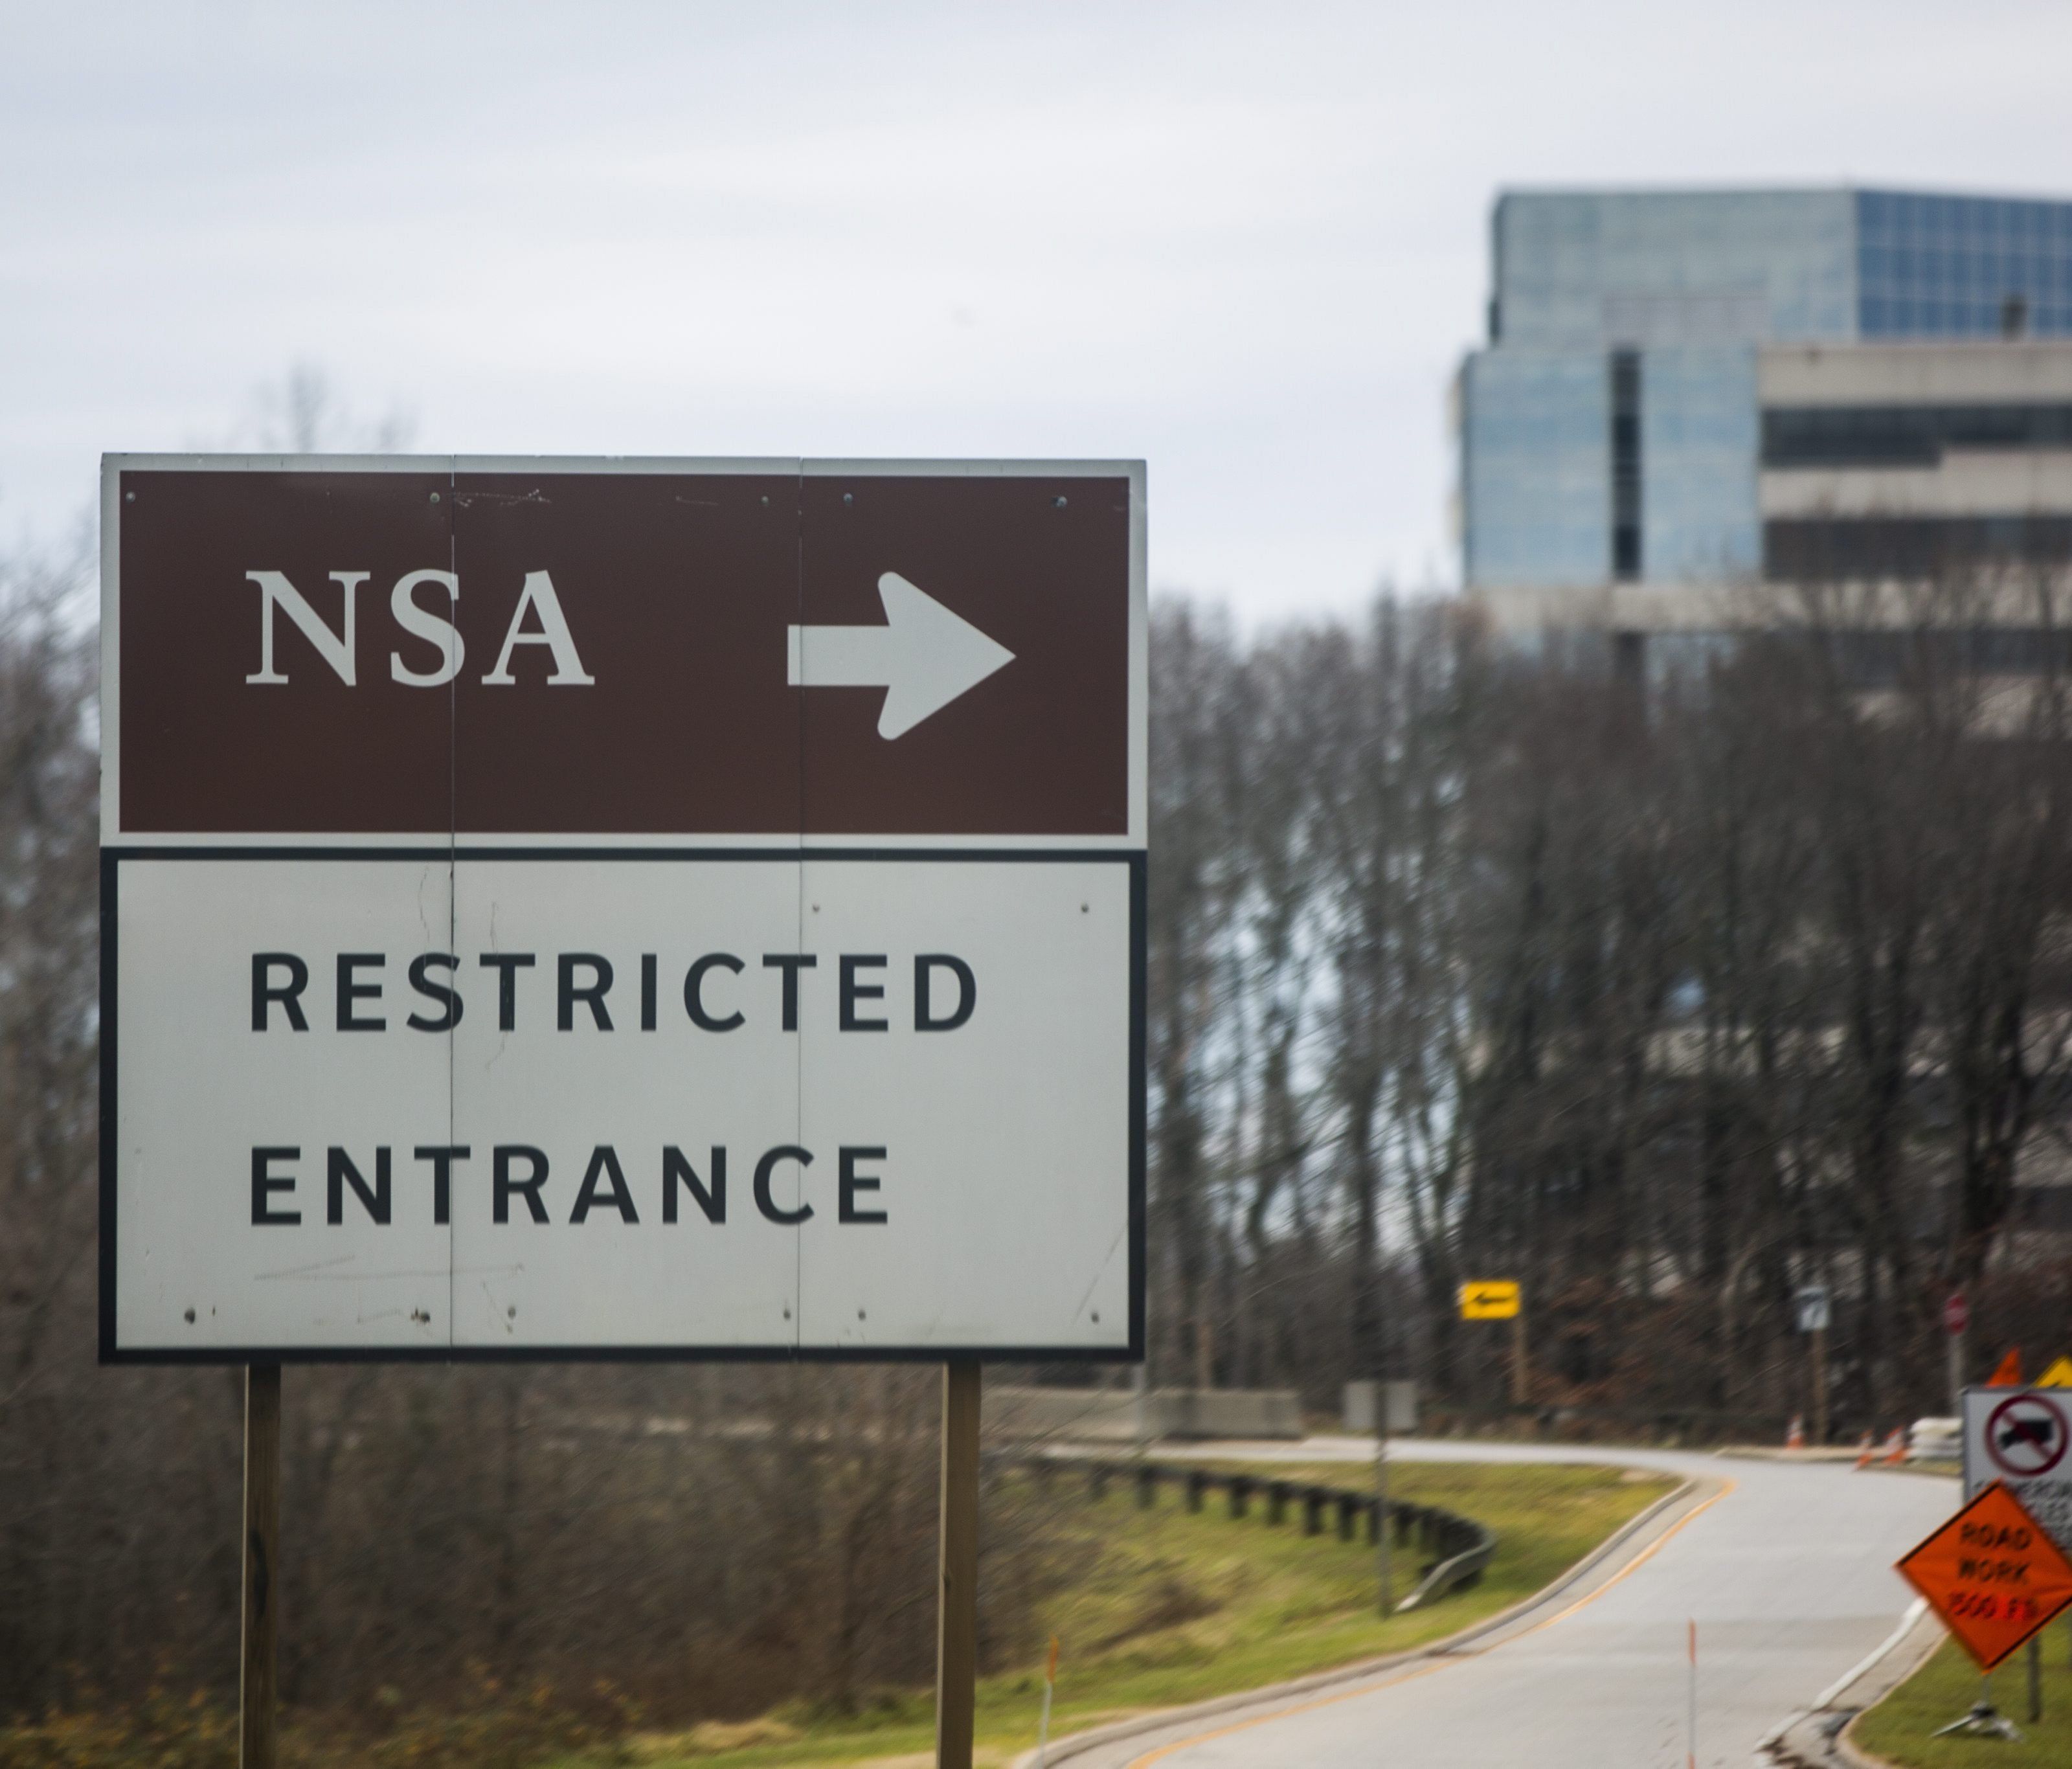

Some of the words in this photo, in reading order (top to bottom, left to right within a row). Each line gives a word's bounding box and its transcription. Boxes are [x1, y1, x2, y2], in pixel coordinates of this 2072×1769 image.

[245, 569, 595, 687] NSA
[251, 952, 976, 1033] RESTRICTED
[251, 1145, 888, 1226] ENTRANCE
[1959, 1559, 2031, 1584] WORK
[1960, 1522, 2032, 1550] ROAD
